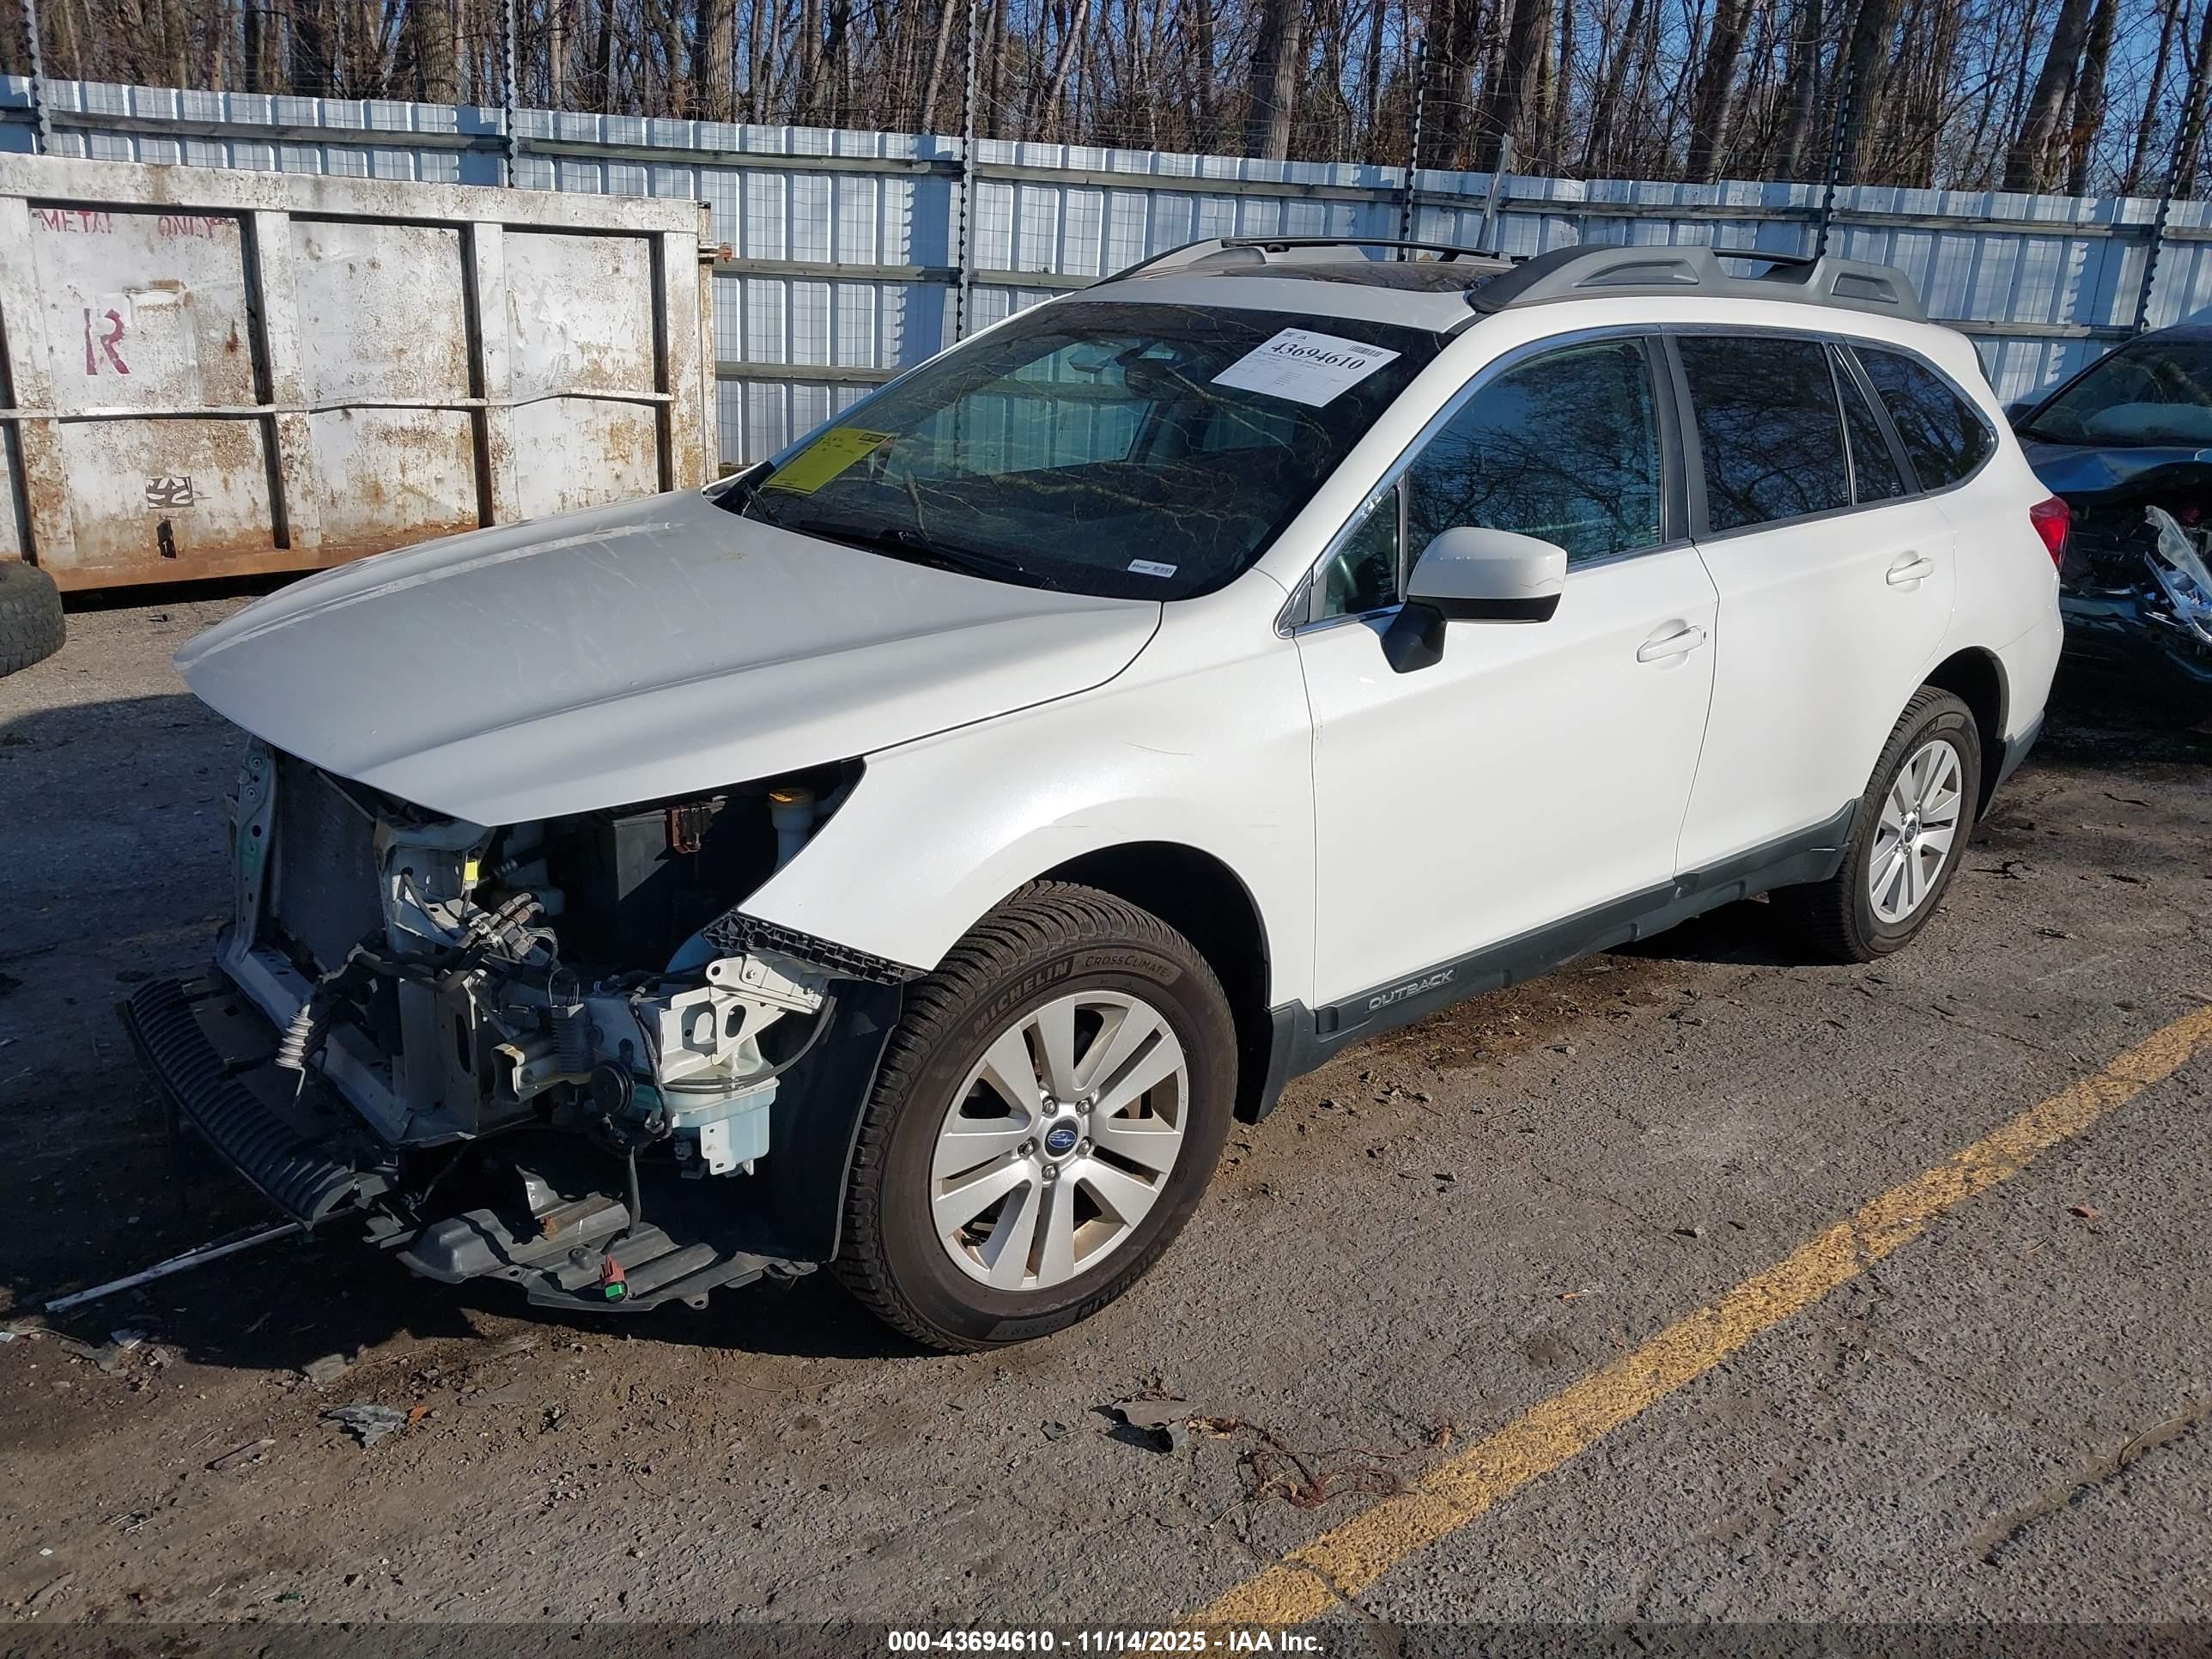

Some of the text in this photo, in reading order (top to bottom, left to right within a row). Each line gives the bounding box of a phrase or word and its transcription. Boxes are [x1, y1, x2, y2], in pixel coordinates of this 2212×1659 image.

[1271, 342, 1365, 370] 43694610
[974, 960, 1070, 1036] MICHELIN
[1368, 969, 1455, 1011] OUTBACK
